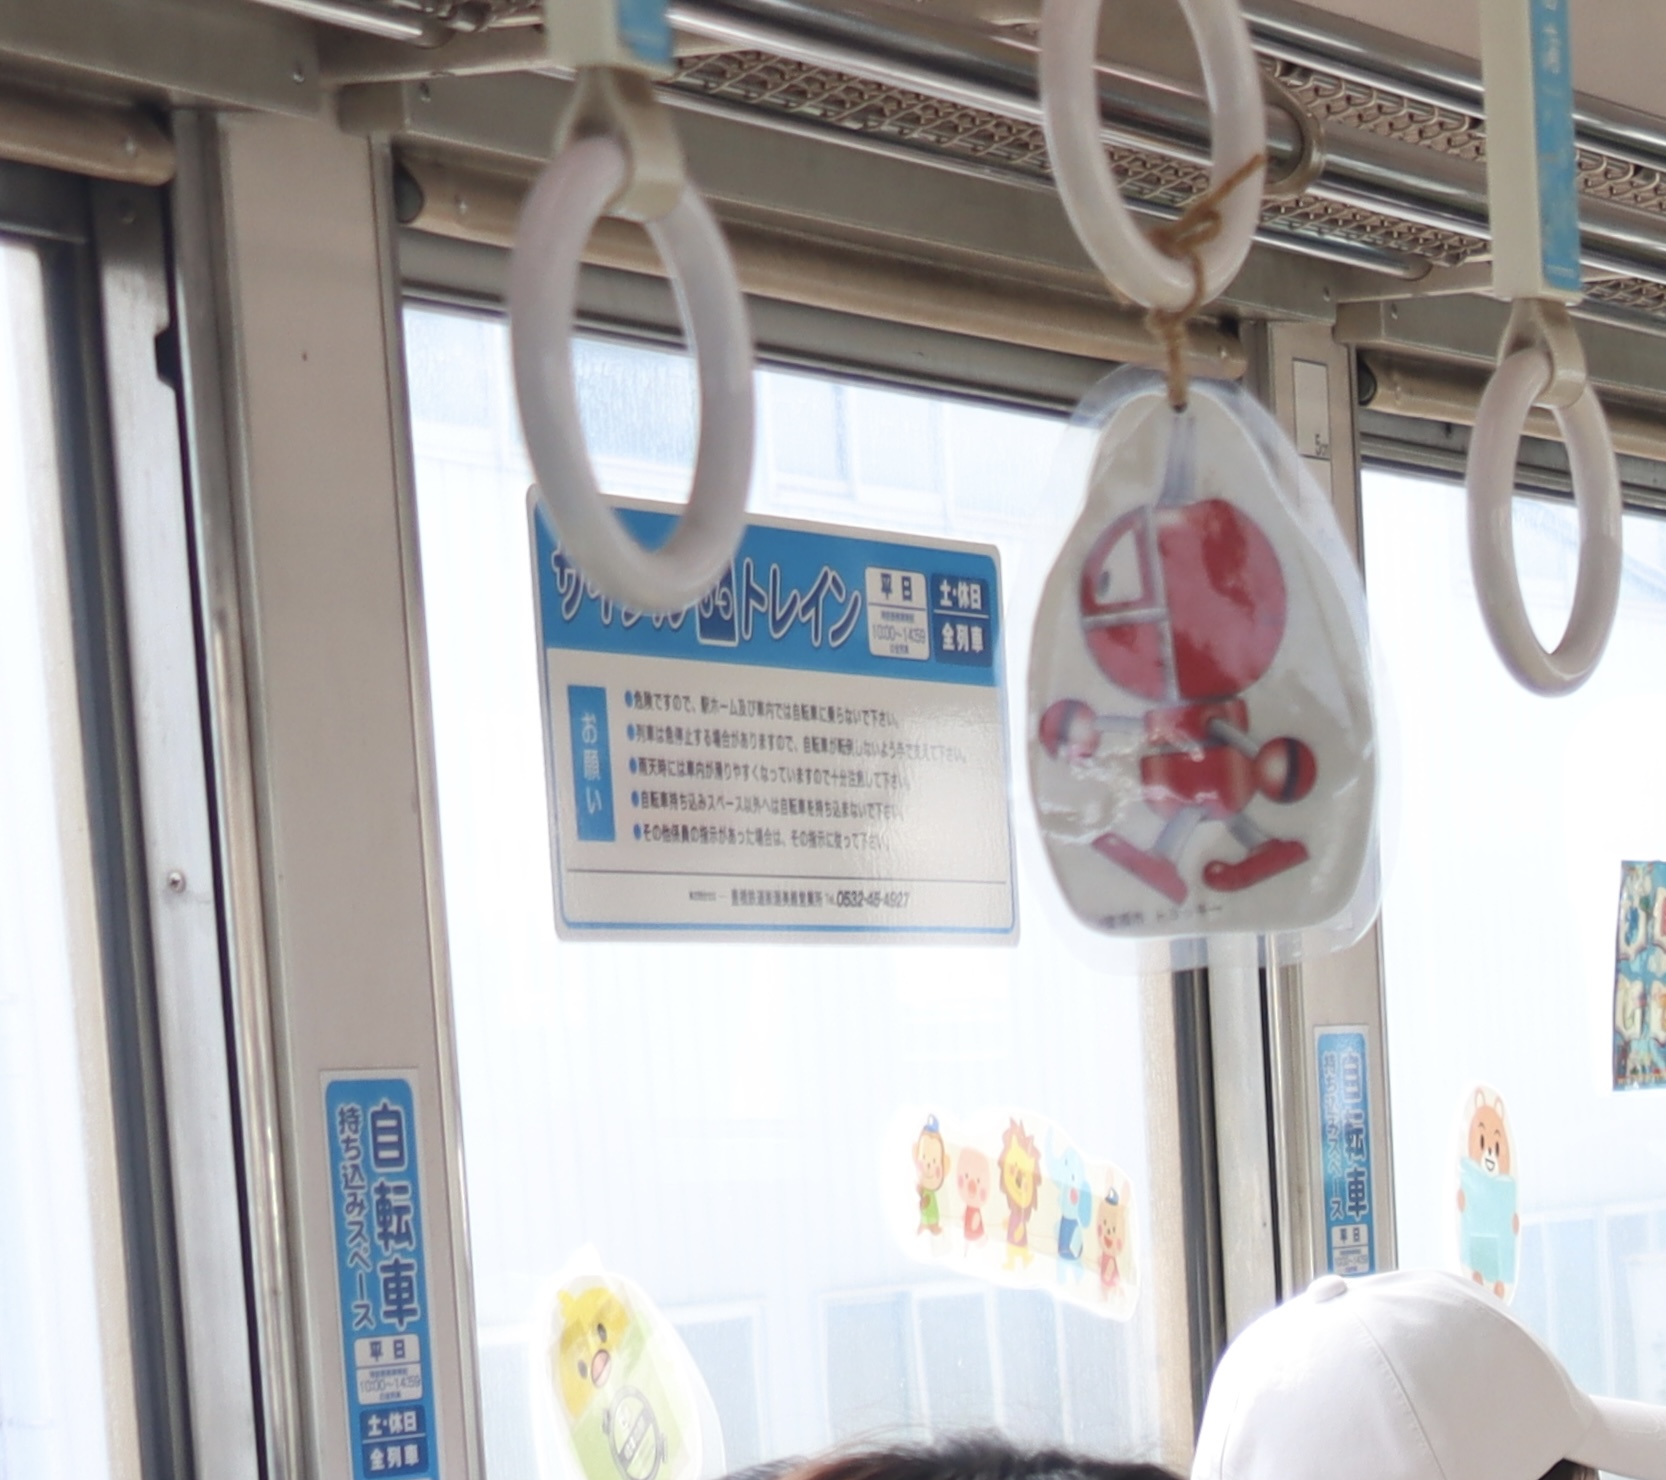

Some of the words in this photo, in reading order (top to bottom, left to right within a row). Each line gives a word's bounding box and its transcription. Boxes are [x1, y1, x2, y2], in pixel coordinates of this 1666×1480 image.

[880, 572, 914, 602] 平日
[938, 578, 983, 610] 土・休日
[941, 621, 984, 653] 全列車
[579, 712, 603, 816] お願い
[338, 1103, 375, 1330] 持ち込みスペース
[369, 1100, 421, 1333] 自転車
[369, 1340, 407, 1362] 平日
[367, 1411, 418, 1438] 土・休日
[369, 1444, 420, 1472] 全列車
